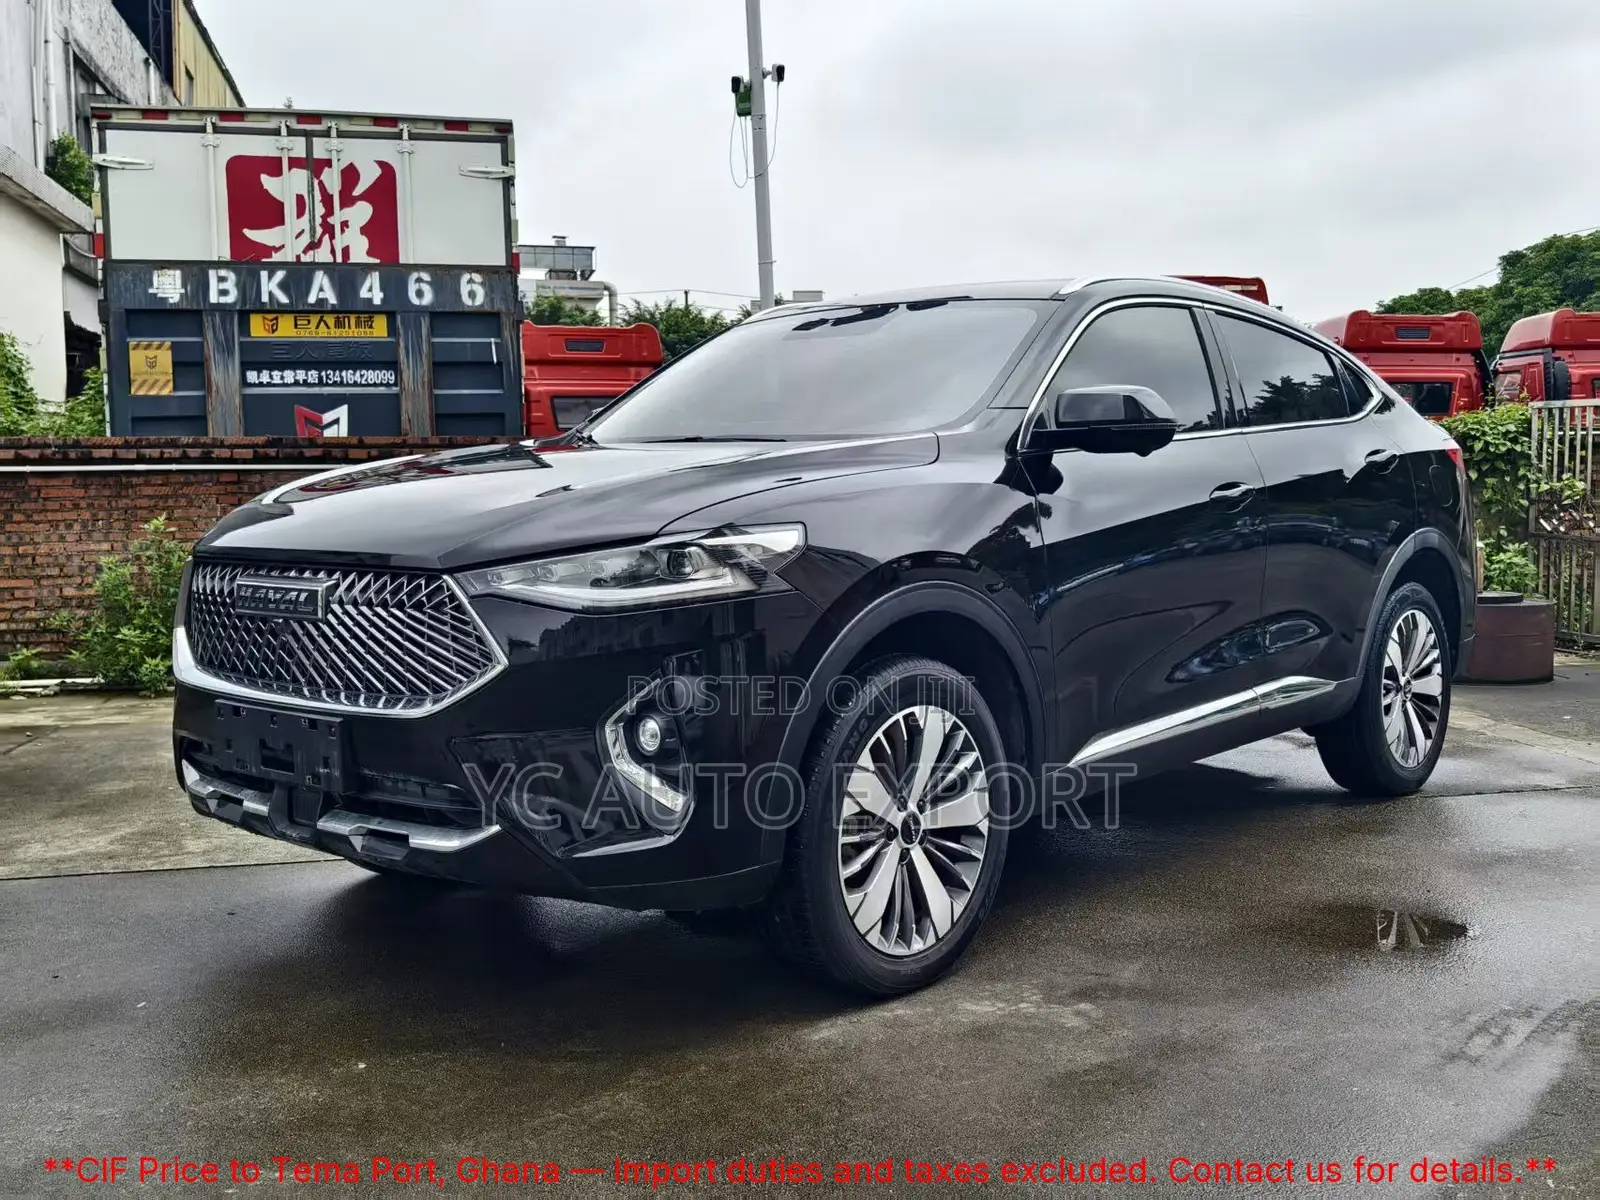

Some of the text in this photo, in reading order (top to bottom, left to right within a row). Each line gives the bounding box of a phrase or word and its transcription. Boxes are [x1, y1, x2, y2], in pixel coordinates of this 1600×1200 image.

[293, 315, 375, 330] 巨人机械
[320, 370, 396, 384] 13416428099
[239, 586, 314, 612] HAVAL
